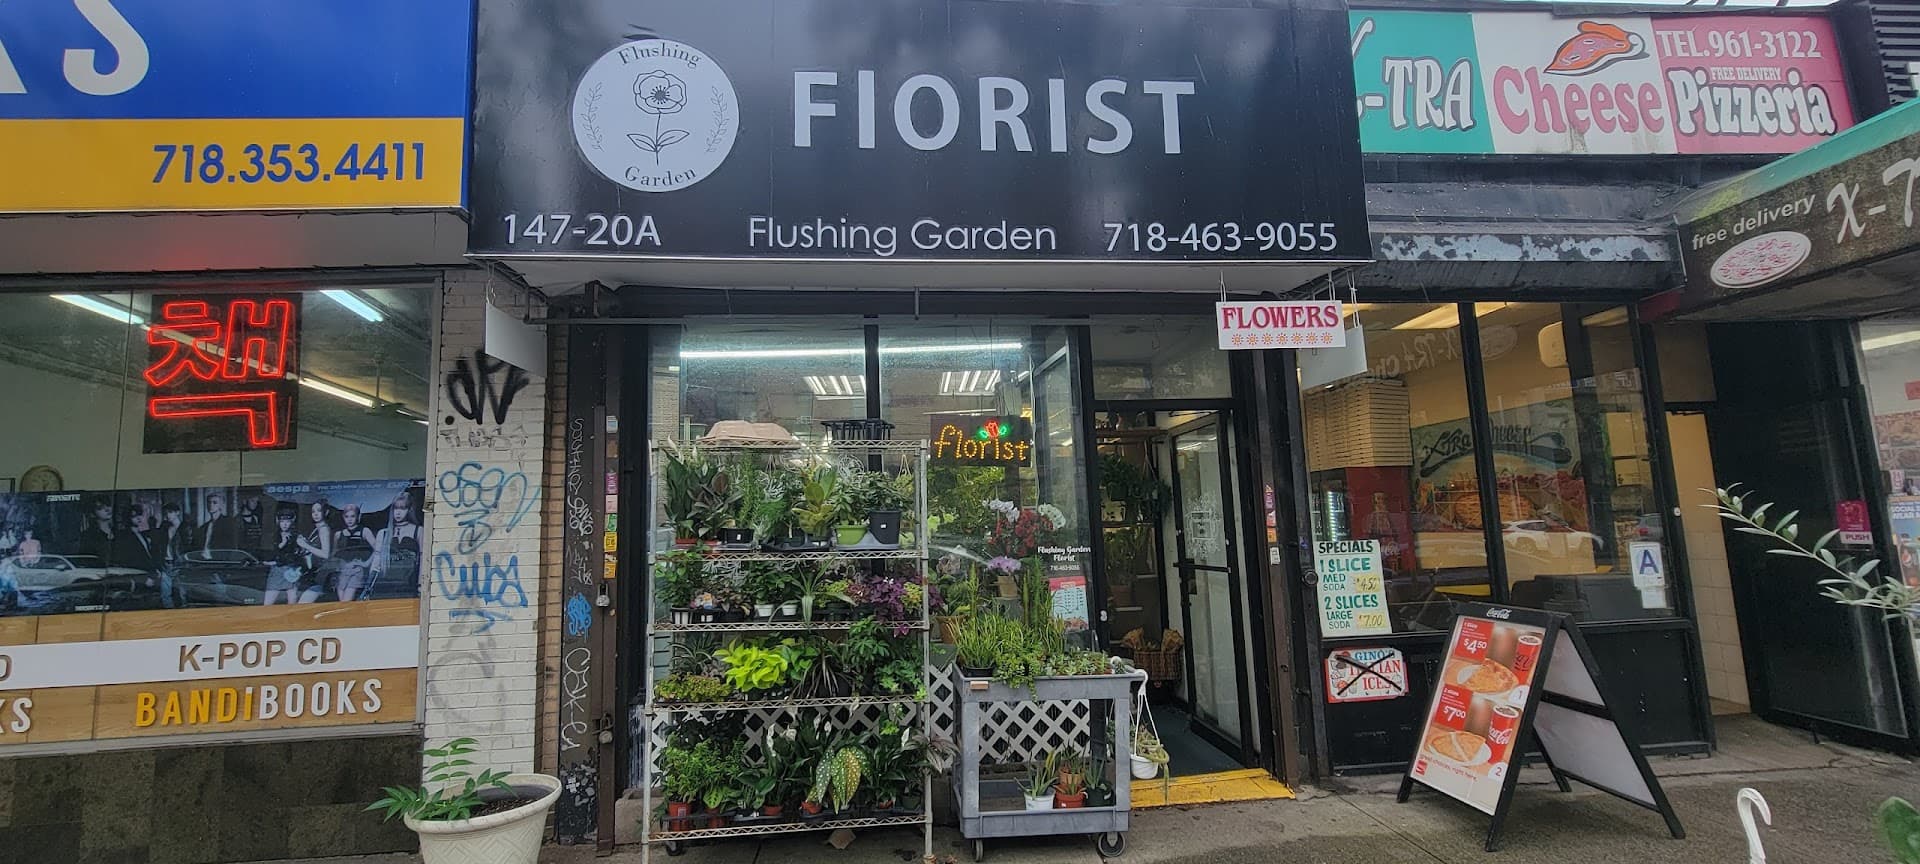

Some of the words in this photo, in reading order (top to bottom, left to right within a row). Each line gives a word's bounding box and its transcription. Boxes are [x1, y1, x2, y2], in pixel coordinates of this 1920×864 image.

[616, 42, 702, 69] Flushing
[1711, 67, 1735, 80] FREE
[1737, 66, 1781, 81] DELIVERY
[1493, 65, 1665, 134] Cheese
[1667, 67, 1837, 135] Pizzeria
[152, 143, 426, 184] 718.353.4411
[624, 164, 697, 188] Garden
[503, 213, 662, 247] 147-20A
[1692, 227, 1728, 250] free
[1733, 194, 1816, 235] delivery
[748, 217, 897, 257] Flushing
[911, 218, 1057, 251] Garden
[1103, 221, 1338, 253] 718-463-9055
[1222, 304, 1340, 331] FLOWERS
[143, 298, 293, 450] 책
[935, 425, 1029, 461] florist
[267, 484, 311, 494] aespa
[1067, 545, 1091, 554] Garden
[1318, 541, 1374, 554] SPECIALS
[1319, 559, 1325, 573] 1
[1328, 558, 1371, 573] SLICE
[1639, 549, 1660, 575] A
[1323, 573, 1346, 583] MED
[1324, 596, 1331, 610] 2
[1335, 594, 1378, 610] SLICES
[1326, 610, 1353, 621] LARGE
[1329, 621, 1351, 629] SODA
[179, 638, 286, 673] K-POP
[297, 637, 342, 666] CD
